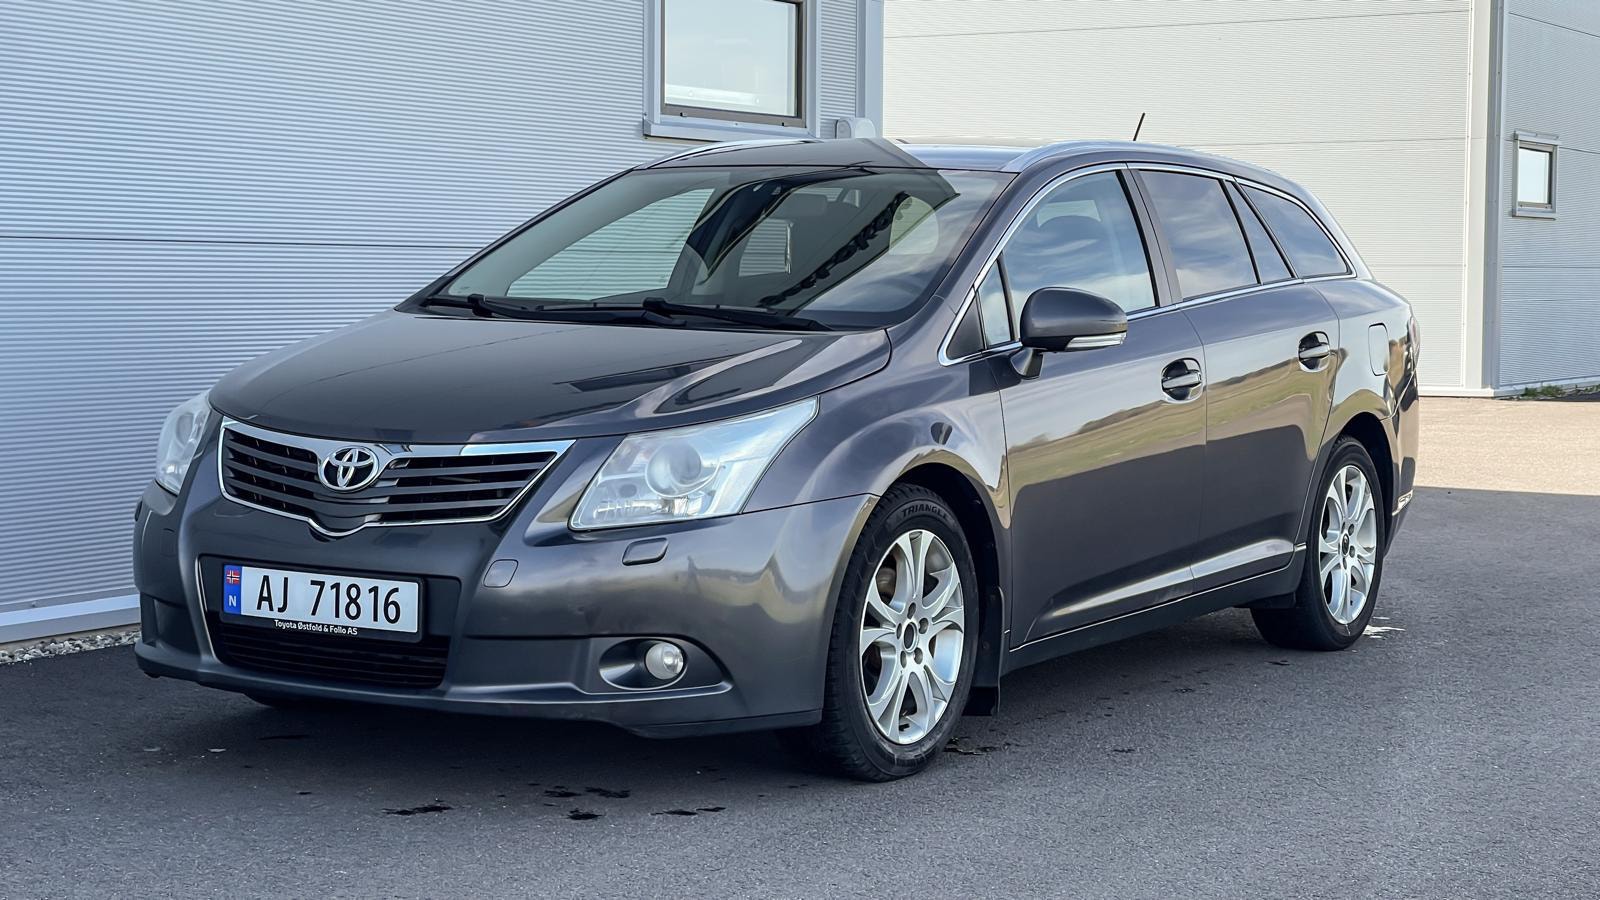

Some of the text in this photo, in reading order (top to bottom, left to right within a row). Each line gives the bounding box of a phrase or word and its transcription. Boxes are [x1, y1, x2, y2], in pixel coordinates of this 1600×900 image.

[228, 594, 237, 607] N
[256, 575, 401, 624] AJ 71816
[274, 619, 358, 635] Toyota Østfold & Follo AS
